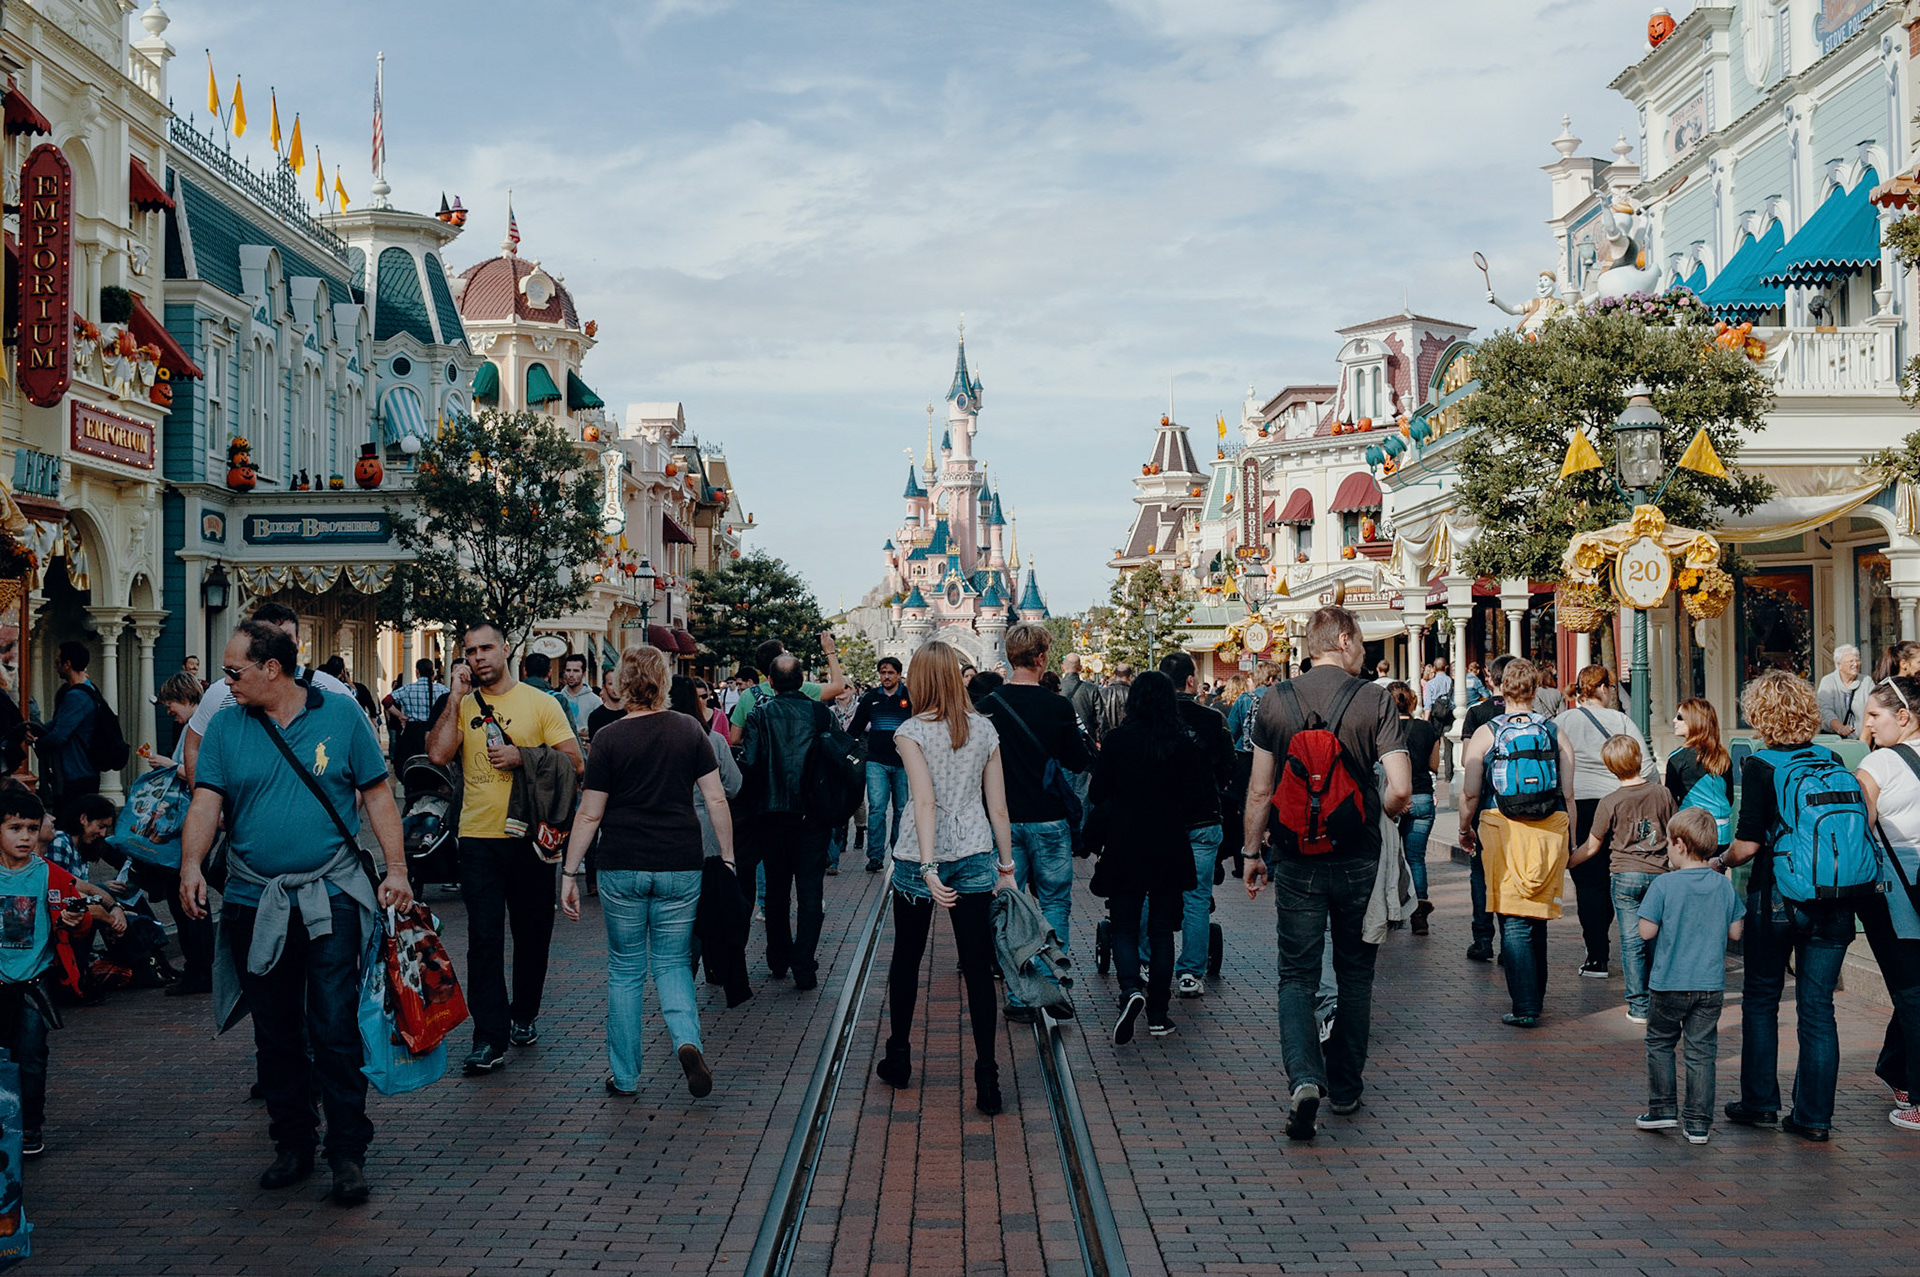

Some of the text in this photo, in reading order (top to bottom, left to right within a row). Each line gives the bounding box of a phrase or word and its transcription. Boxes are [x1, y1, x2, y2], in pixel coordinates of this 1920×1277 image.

[1825, 24, 1847, 52] STOVE
[29, 174, 58, 370] EMPORIUM
[84, 417, 148, 454] EMPORIUM
[1246, 465, 1256, 548] MARKET HOUSE
[252, 518, 381, 538] BIXBY BROTHERS
[1628, 560, 1660, 582] 20
[1322, 590, 1397, 604] DCATESSEN
[1249, 631, 1263, 642] 20
